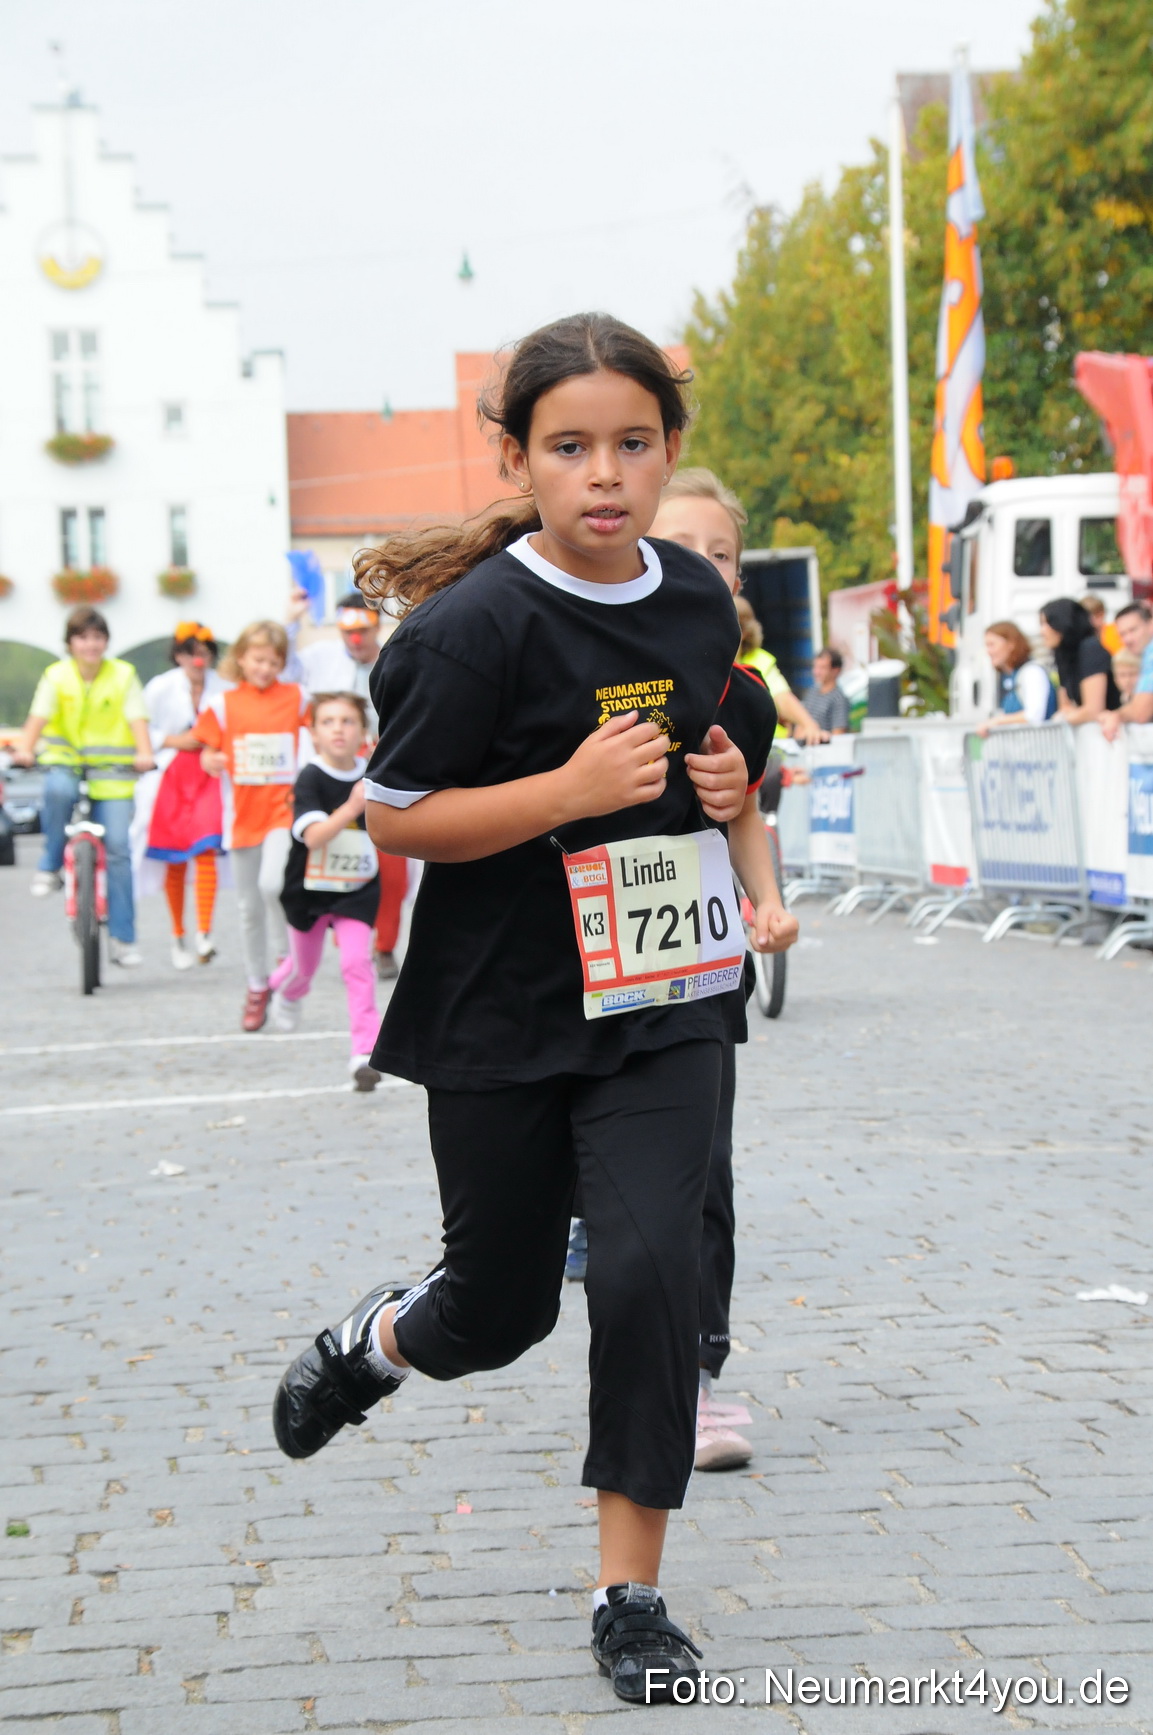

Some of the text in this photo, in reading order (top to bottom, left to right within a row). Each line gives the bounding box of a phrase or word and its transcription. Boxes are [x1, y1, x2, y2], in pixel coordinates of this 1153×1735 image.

[596, 679, 674, 701] NEUMARKTER
[600, 694, 668, 713] STADTLAUF
[329, 853, 373, 873] 7225
[620, 851, 677, 888] Linda
[582, 912, 605, 937] K3
[628, 896, 729, 954] 7210
[687, 966, 740, 990] PFLEIDERER
[602, 989, 647, 1007] BOCK
[322, 1334, 339, 1358] ESPRIT
[709, 1334, 730, 1343] ROSS
